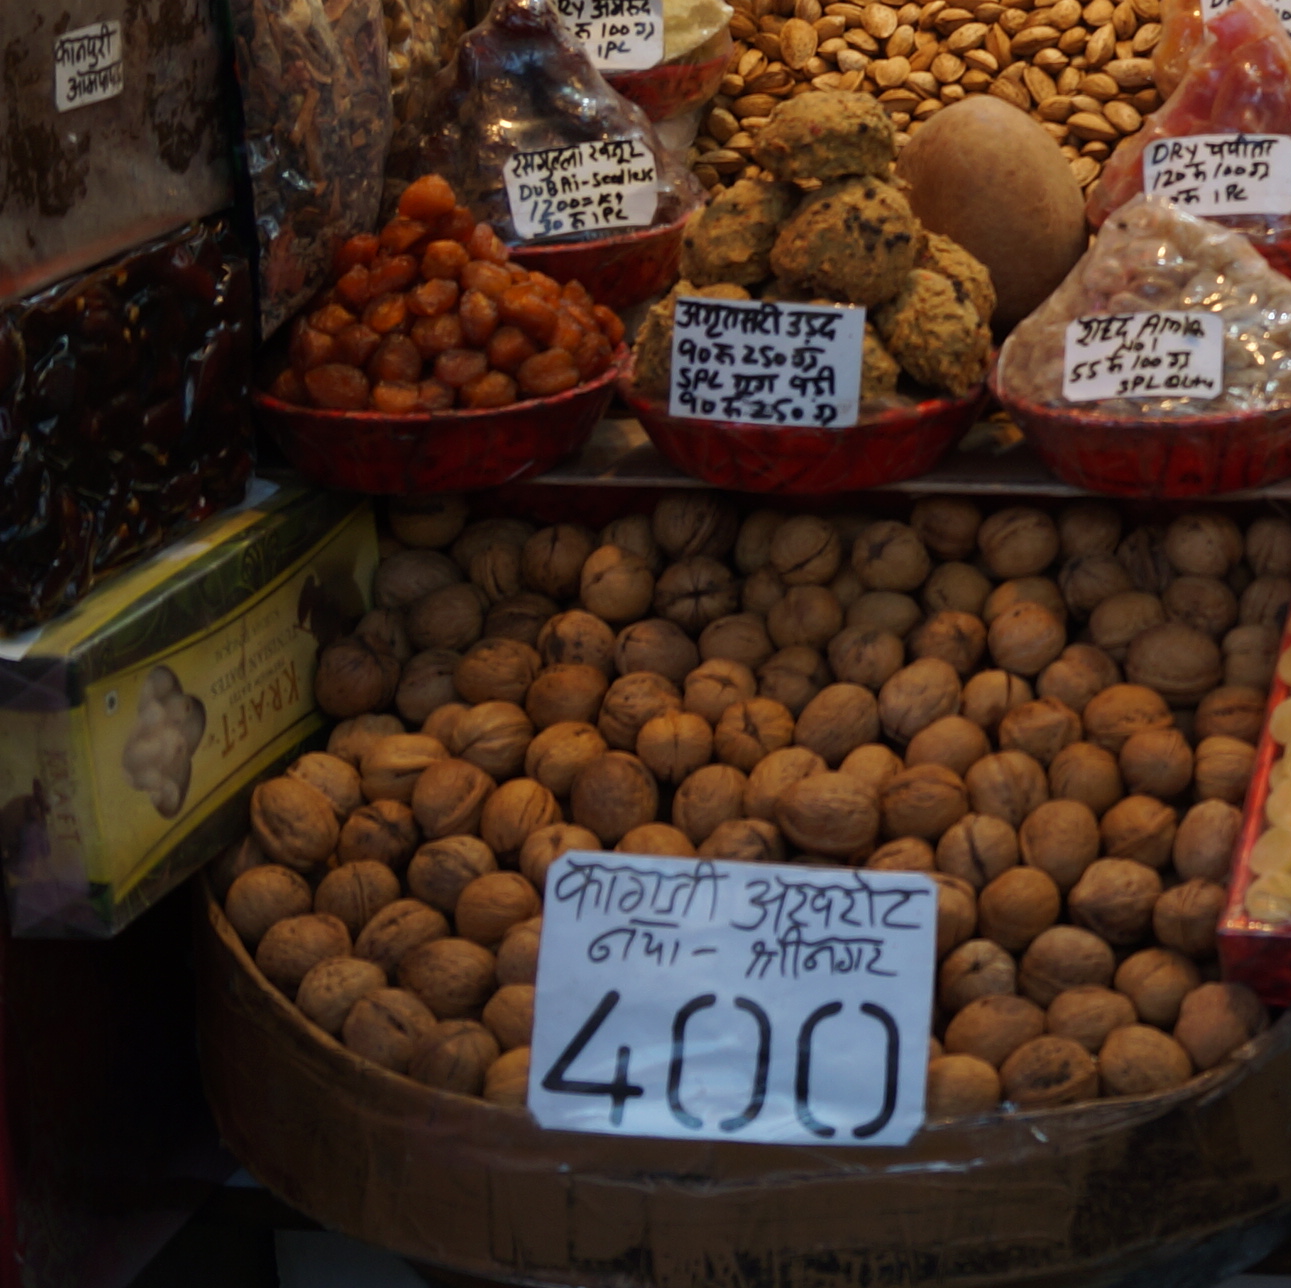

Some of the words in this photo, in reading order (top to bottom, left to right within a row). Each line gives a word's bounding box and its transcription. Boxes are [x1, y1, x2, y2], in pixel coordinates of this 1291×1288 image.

[1152, 142, 1198, 164] DRY
[555, 859, 728, 920] कागजी
[730, 872, 931, 936] अखरोट
[587, 918, 680, 966] नया
[744, 925, 898, 979] श्रीनगर
[541, 990, 900, 1140] 400
